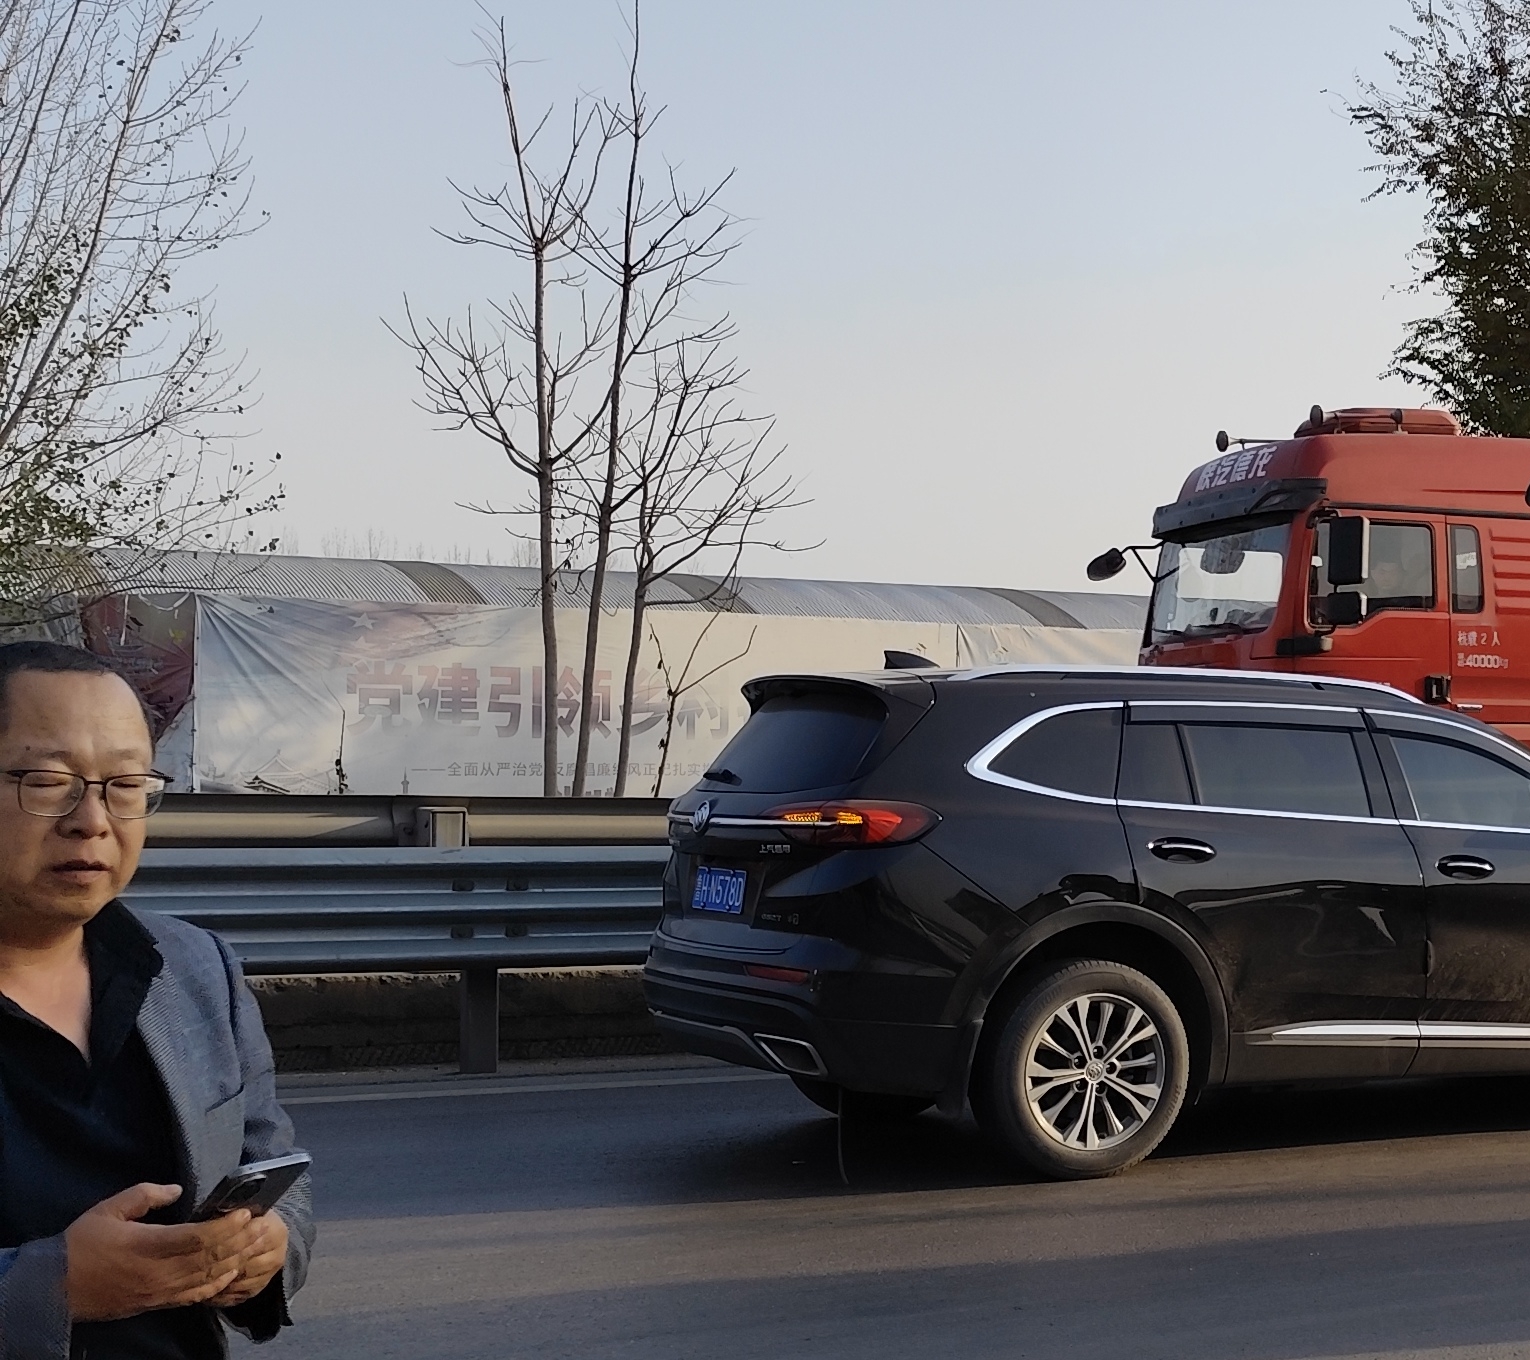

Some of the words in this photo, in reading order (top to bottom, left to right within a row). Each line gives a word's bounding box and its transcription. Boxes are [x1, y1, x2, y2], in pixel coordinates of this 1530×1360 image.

[346, 661, 747, 738] 党建引领乡村
